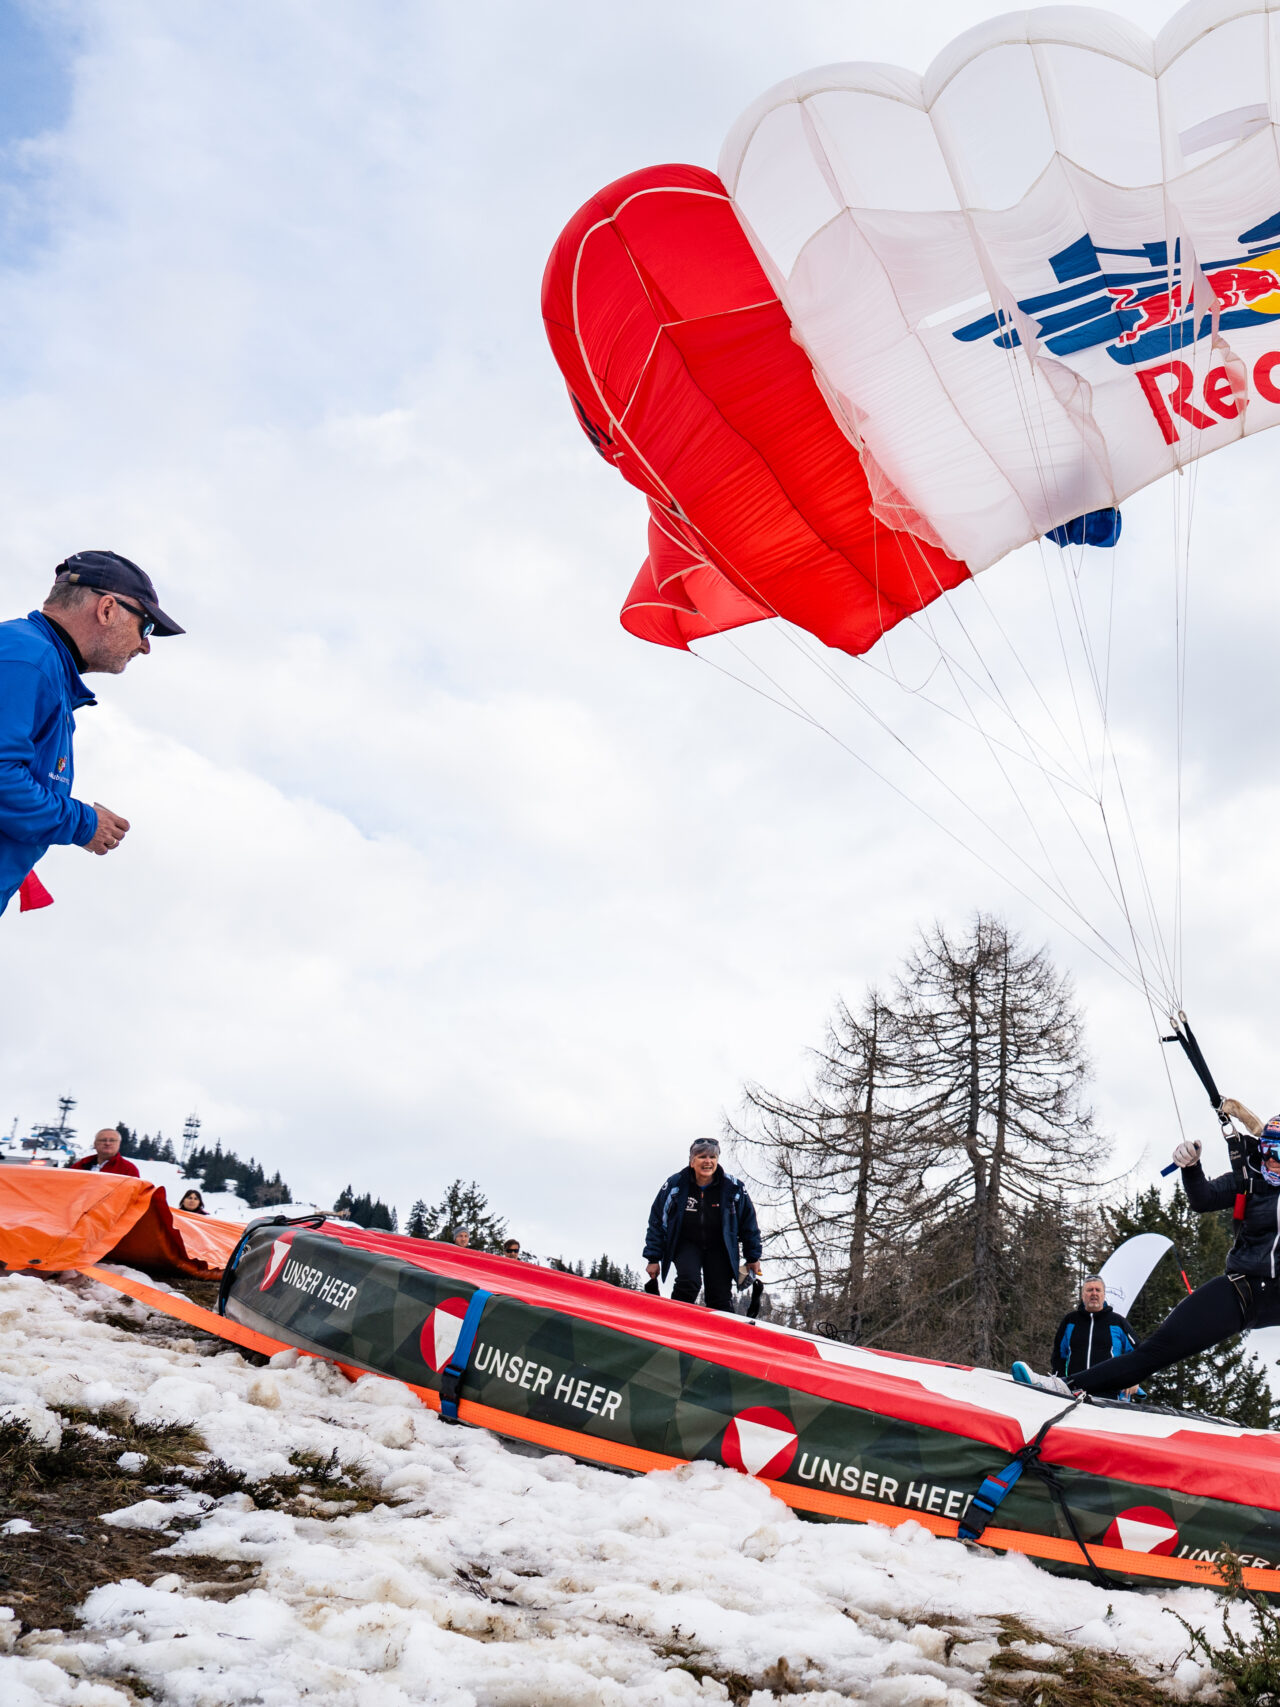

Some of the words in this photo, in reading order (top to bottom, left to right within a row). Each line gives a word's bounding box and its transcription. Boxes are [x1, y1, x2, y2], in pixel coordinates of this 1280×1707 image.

[282, 1258, 323, 1295] UNSER
[317, 1275, 358, 1311] HEER
[474, 1342, 553, 1396] UNSER
[553, 1373, 623, 1421] HEER
[797, 1452, 899, 1503] UNSER
